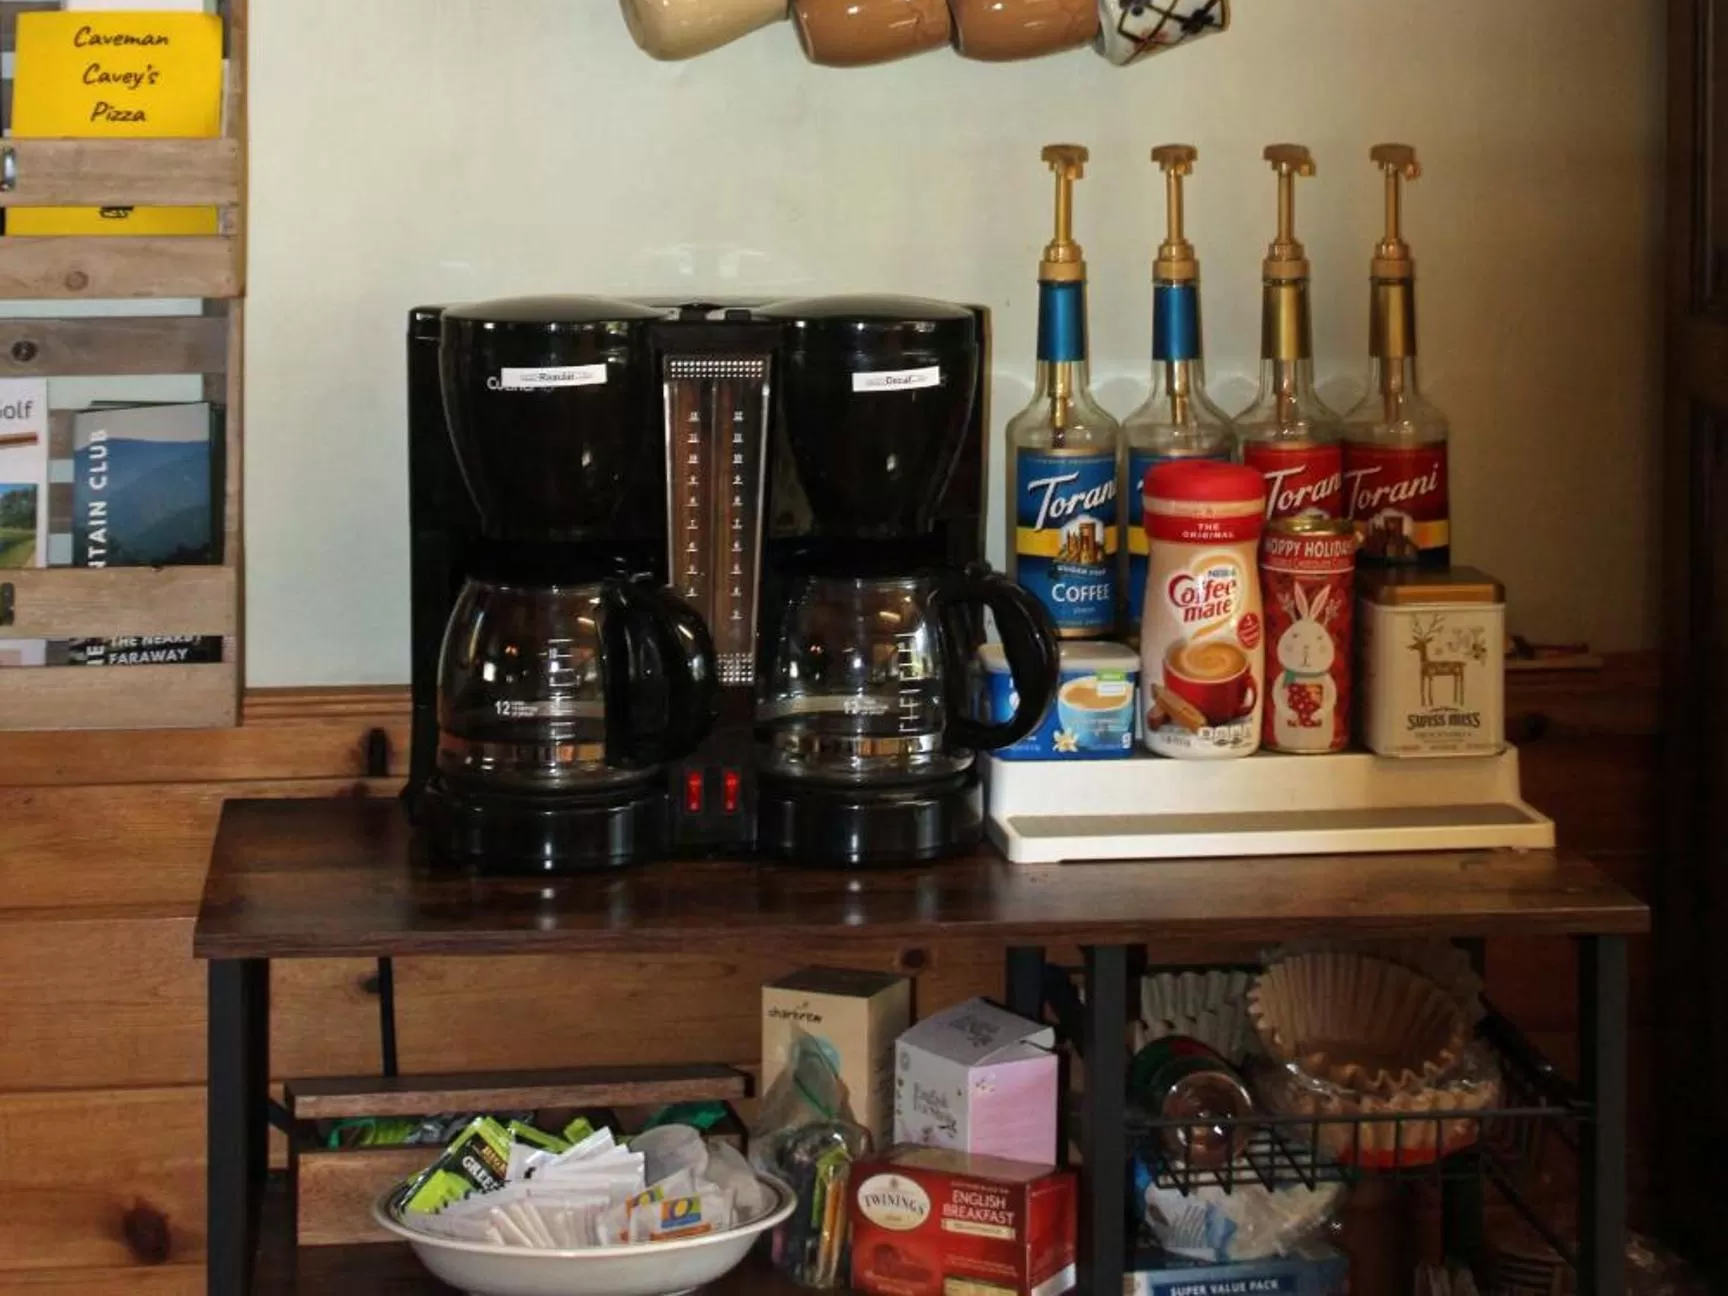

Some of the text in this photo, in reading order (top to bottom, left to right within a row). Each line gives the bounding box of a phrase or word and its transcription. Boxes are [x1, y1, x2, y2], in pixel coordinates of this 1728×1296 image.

[74, 26, 169, 48] Caveman
[83, 62, 160, 90] Cavey's
[90, 101, 147, 122] Pizza
[0, 401, 33, 421] olf
[89, 428, 108, 490] CLUB
[1027, 470, 1117, 532] Toran
[1344, 461, 1440, 520] Torani
[1051, 583, 1111, 602] COFFEE
[1183, 599, 1232, 623] mate
[108, 648, 189, 666] FARAWAY
[495, 700, 510, 716] 12
[462, 1155, 500, 1191] GREE
[864, 1193, 924, 1216] TWININGS
[952, 1189, 1006, 1209] ENGLISH
[943, 1203, 1015, 1225] BREAKFAST
[1211, 1281, 1246, 1294] VALUE
[1249, 1278, 1279, 1291] PACK
